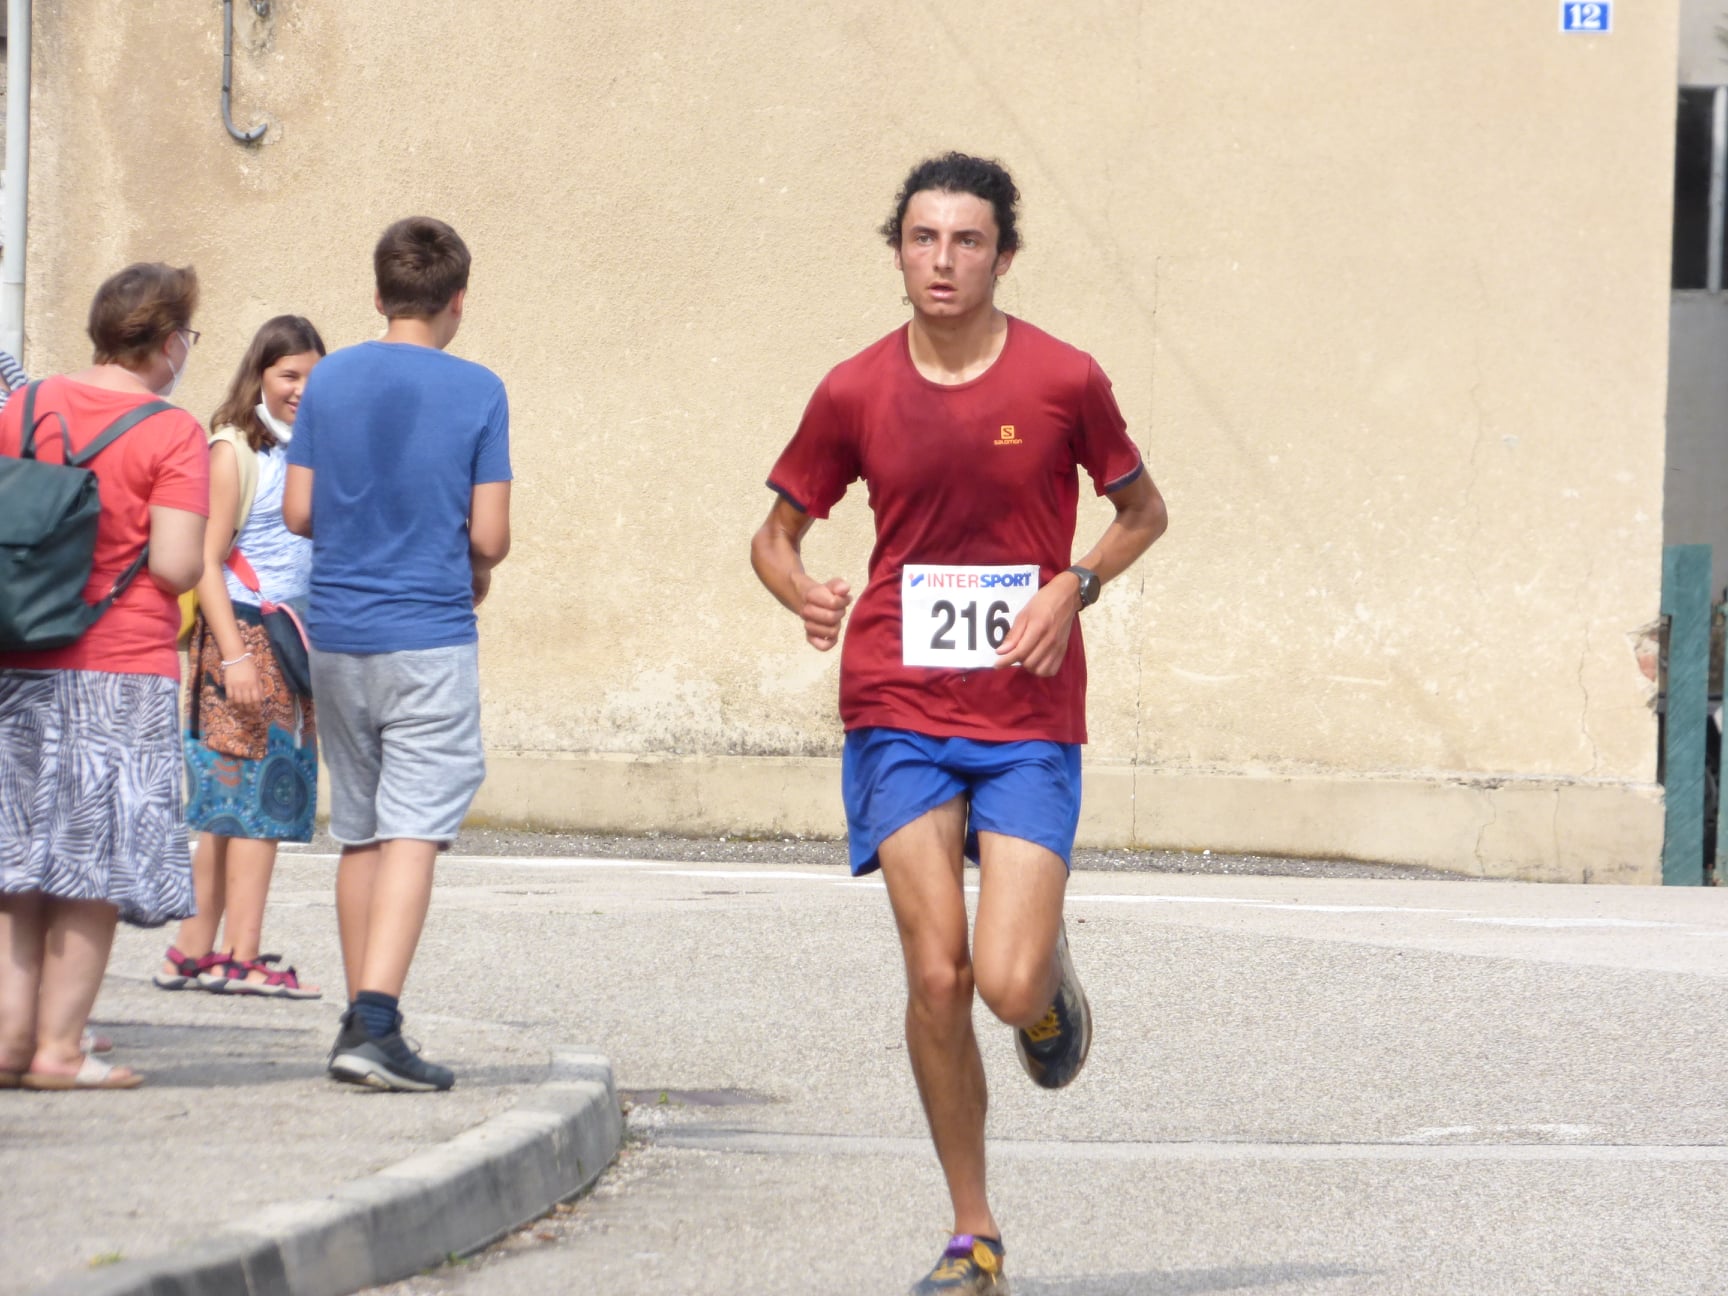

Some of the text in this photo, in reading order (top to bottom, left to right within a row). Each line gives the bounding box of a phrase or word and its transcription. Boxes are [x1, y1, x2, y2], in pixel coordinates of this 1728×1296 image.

[1569, 3, 1602, 28] 12
[927, 573, 1031, 588] INTERSPORT
[930, 599, 1010, 651] 216
